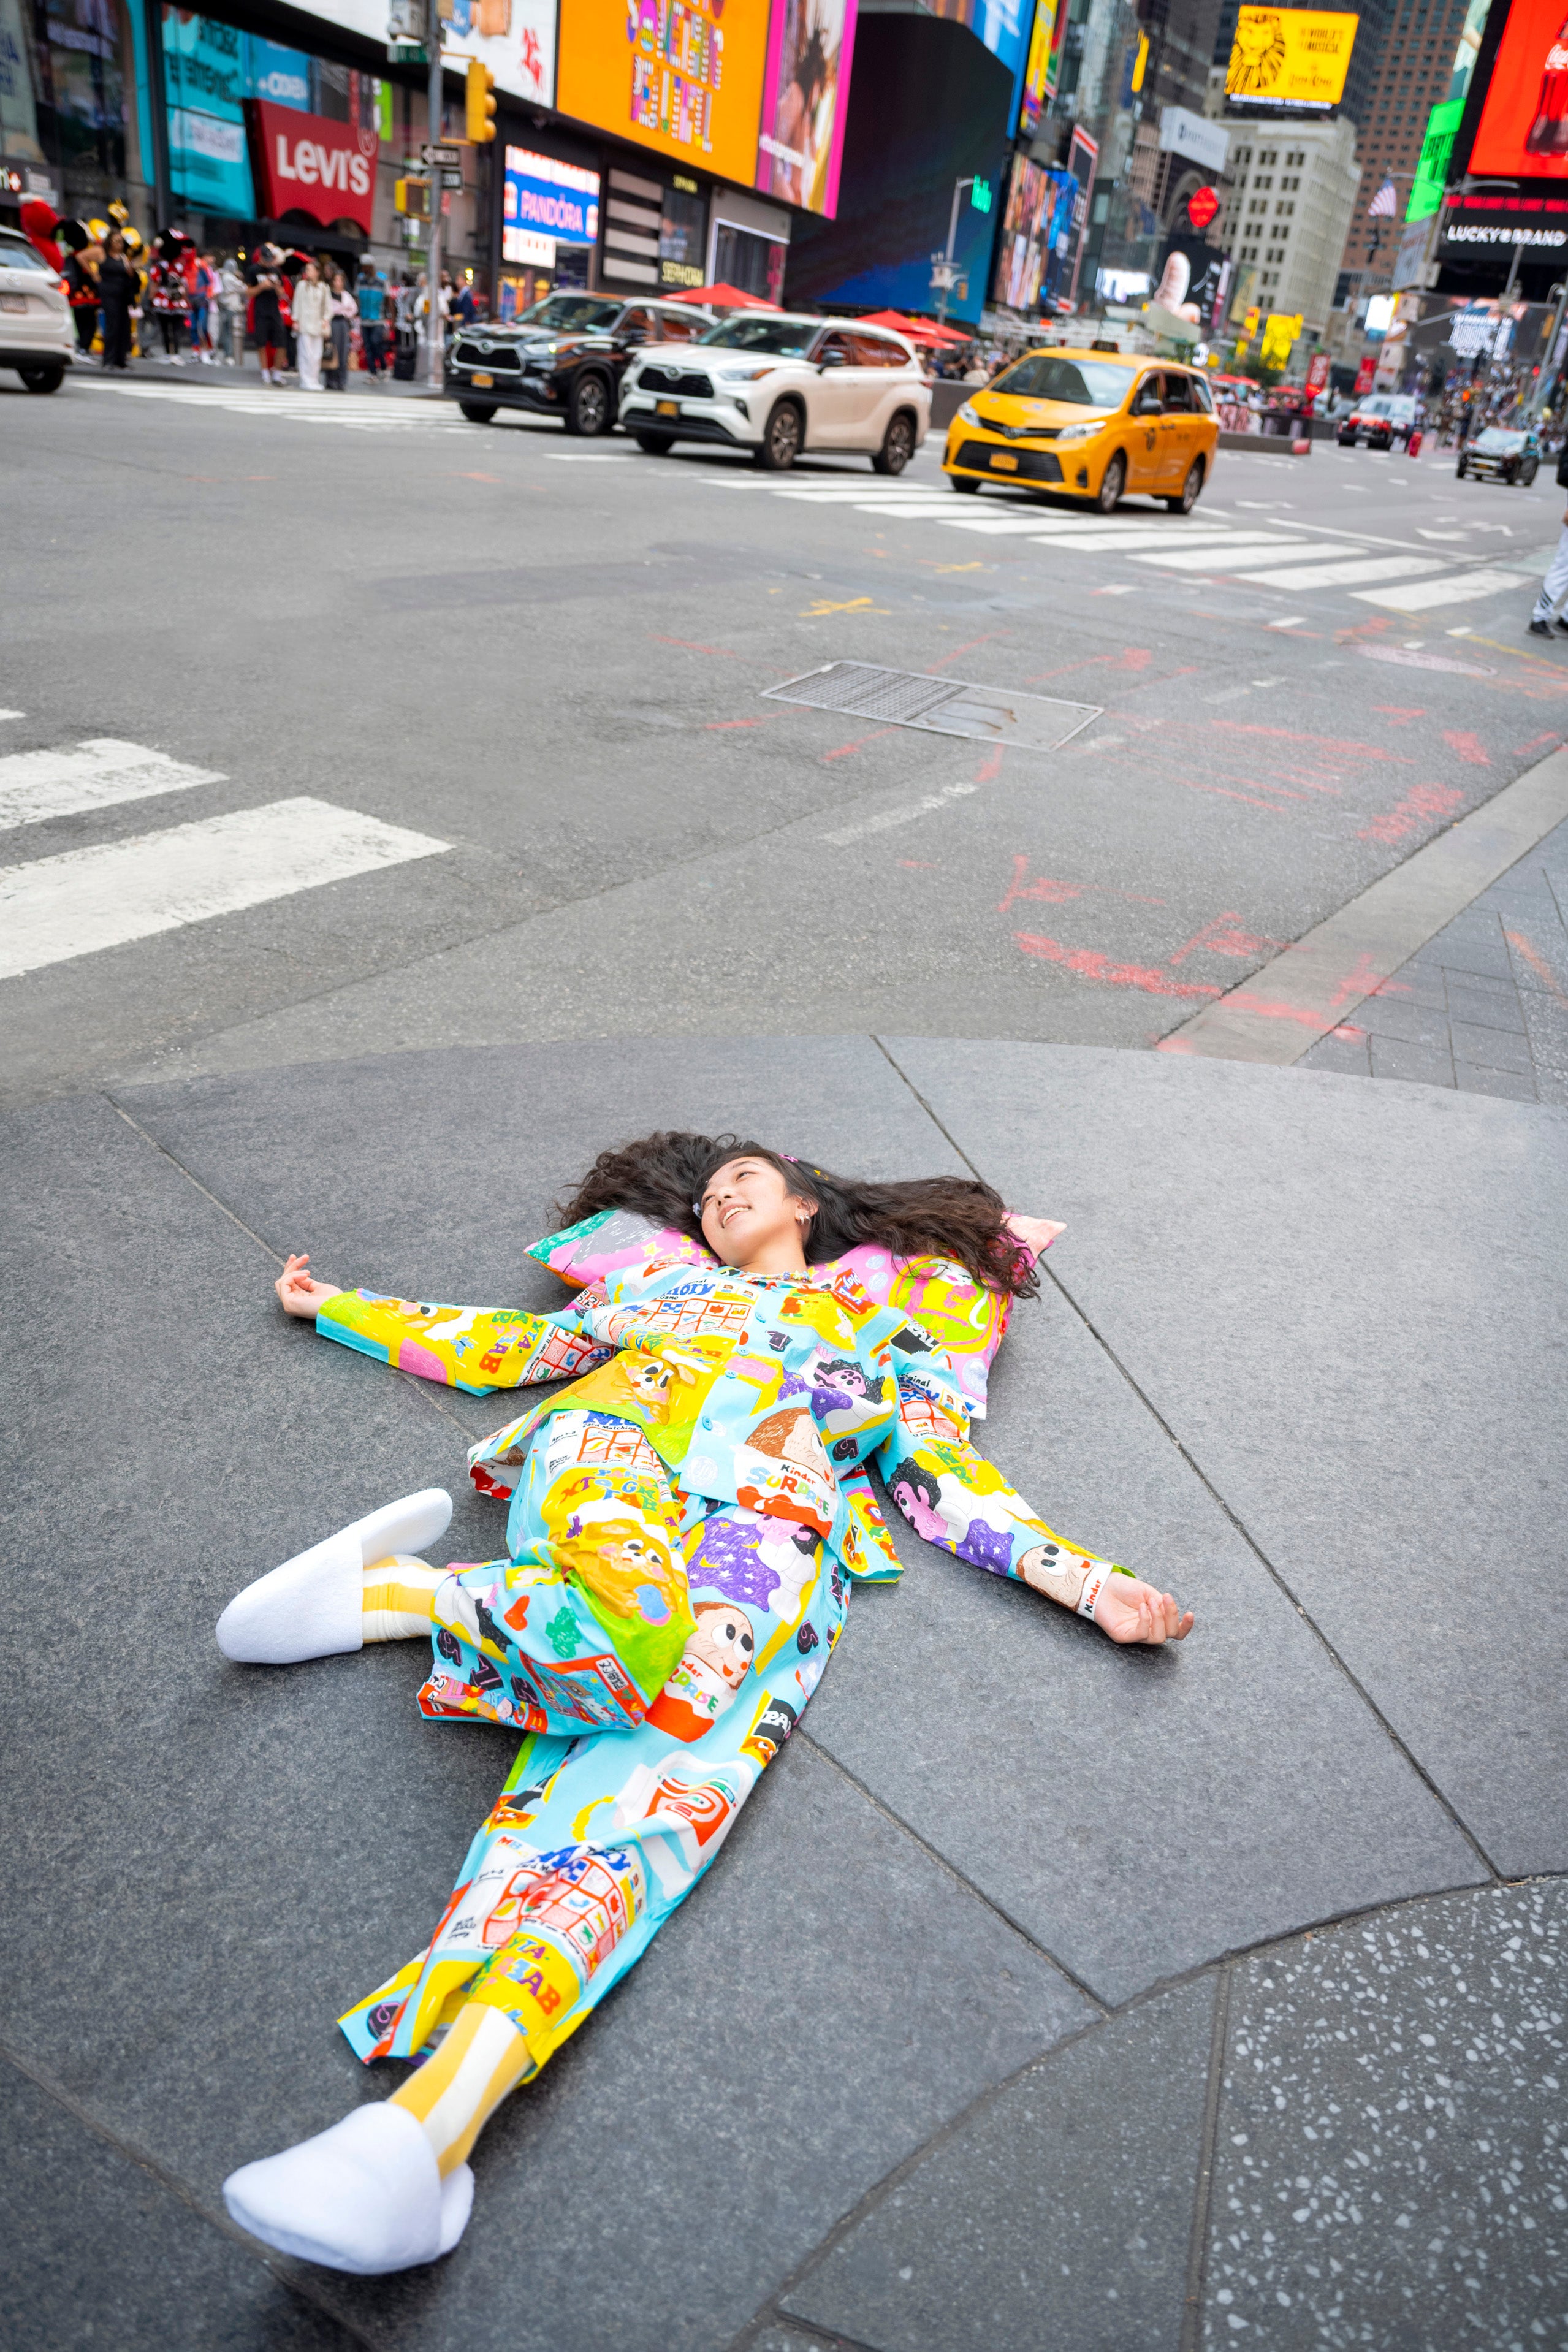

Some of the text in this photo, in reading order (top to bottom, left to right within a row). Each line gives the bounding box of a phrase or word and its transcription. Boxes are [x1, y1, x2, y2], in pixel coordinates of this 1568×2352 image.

[1447, 224, 1567, 247] LUCKY BRAND
[780, 1464, 816, 1485] Kinder
[745, 1466, 830, 1516] SURPRISE
[1084, 1578, 1103, 1613] Kinder
